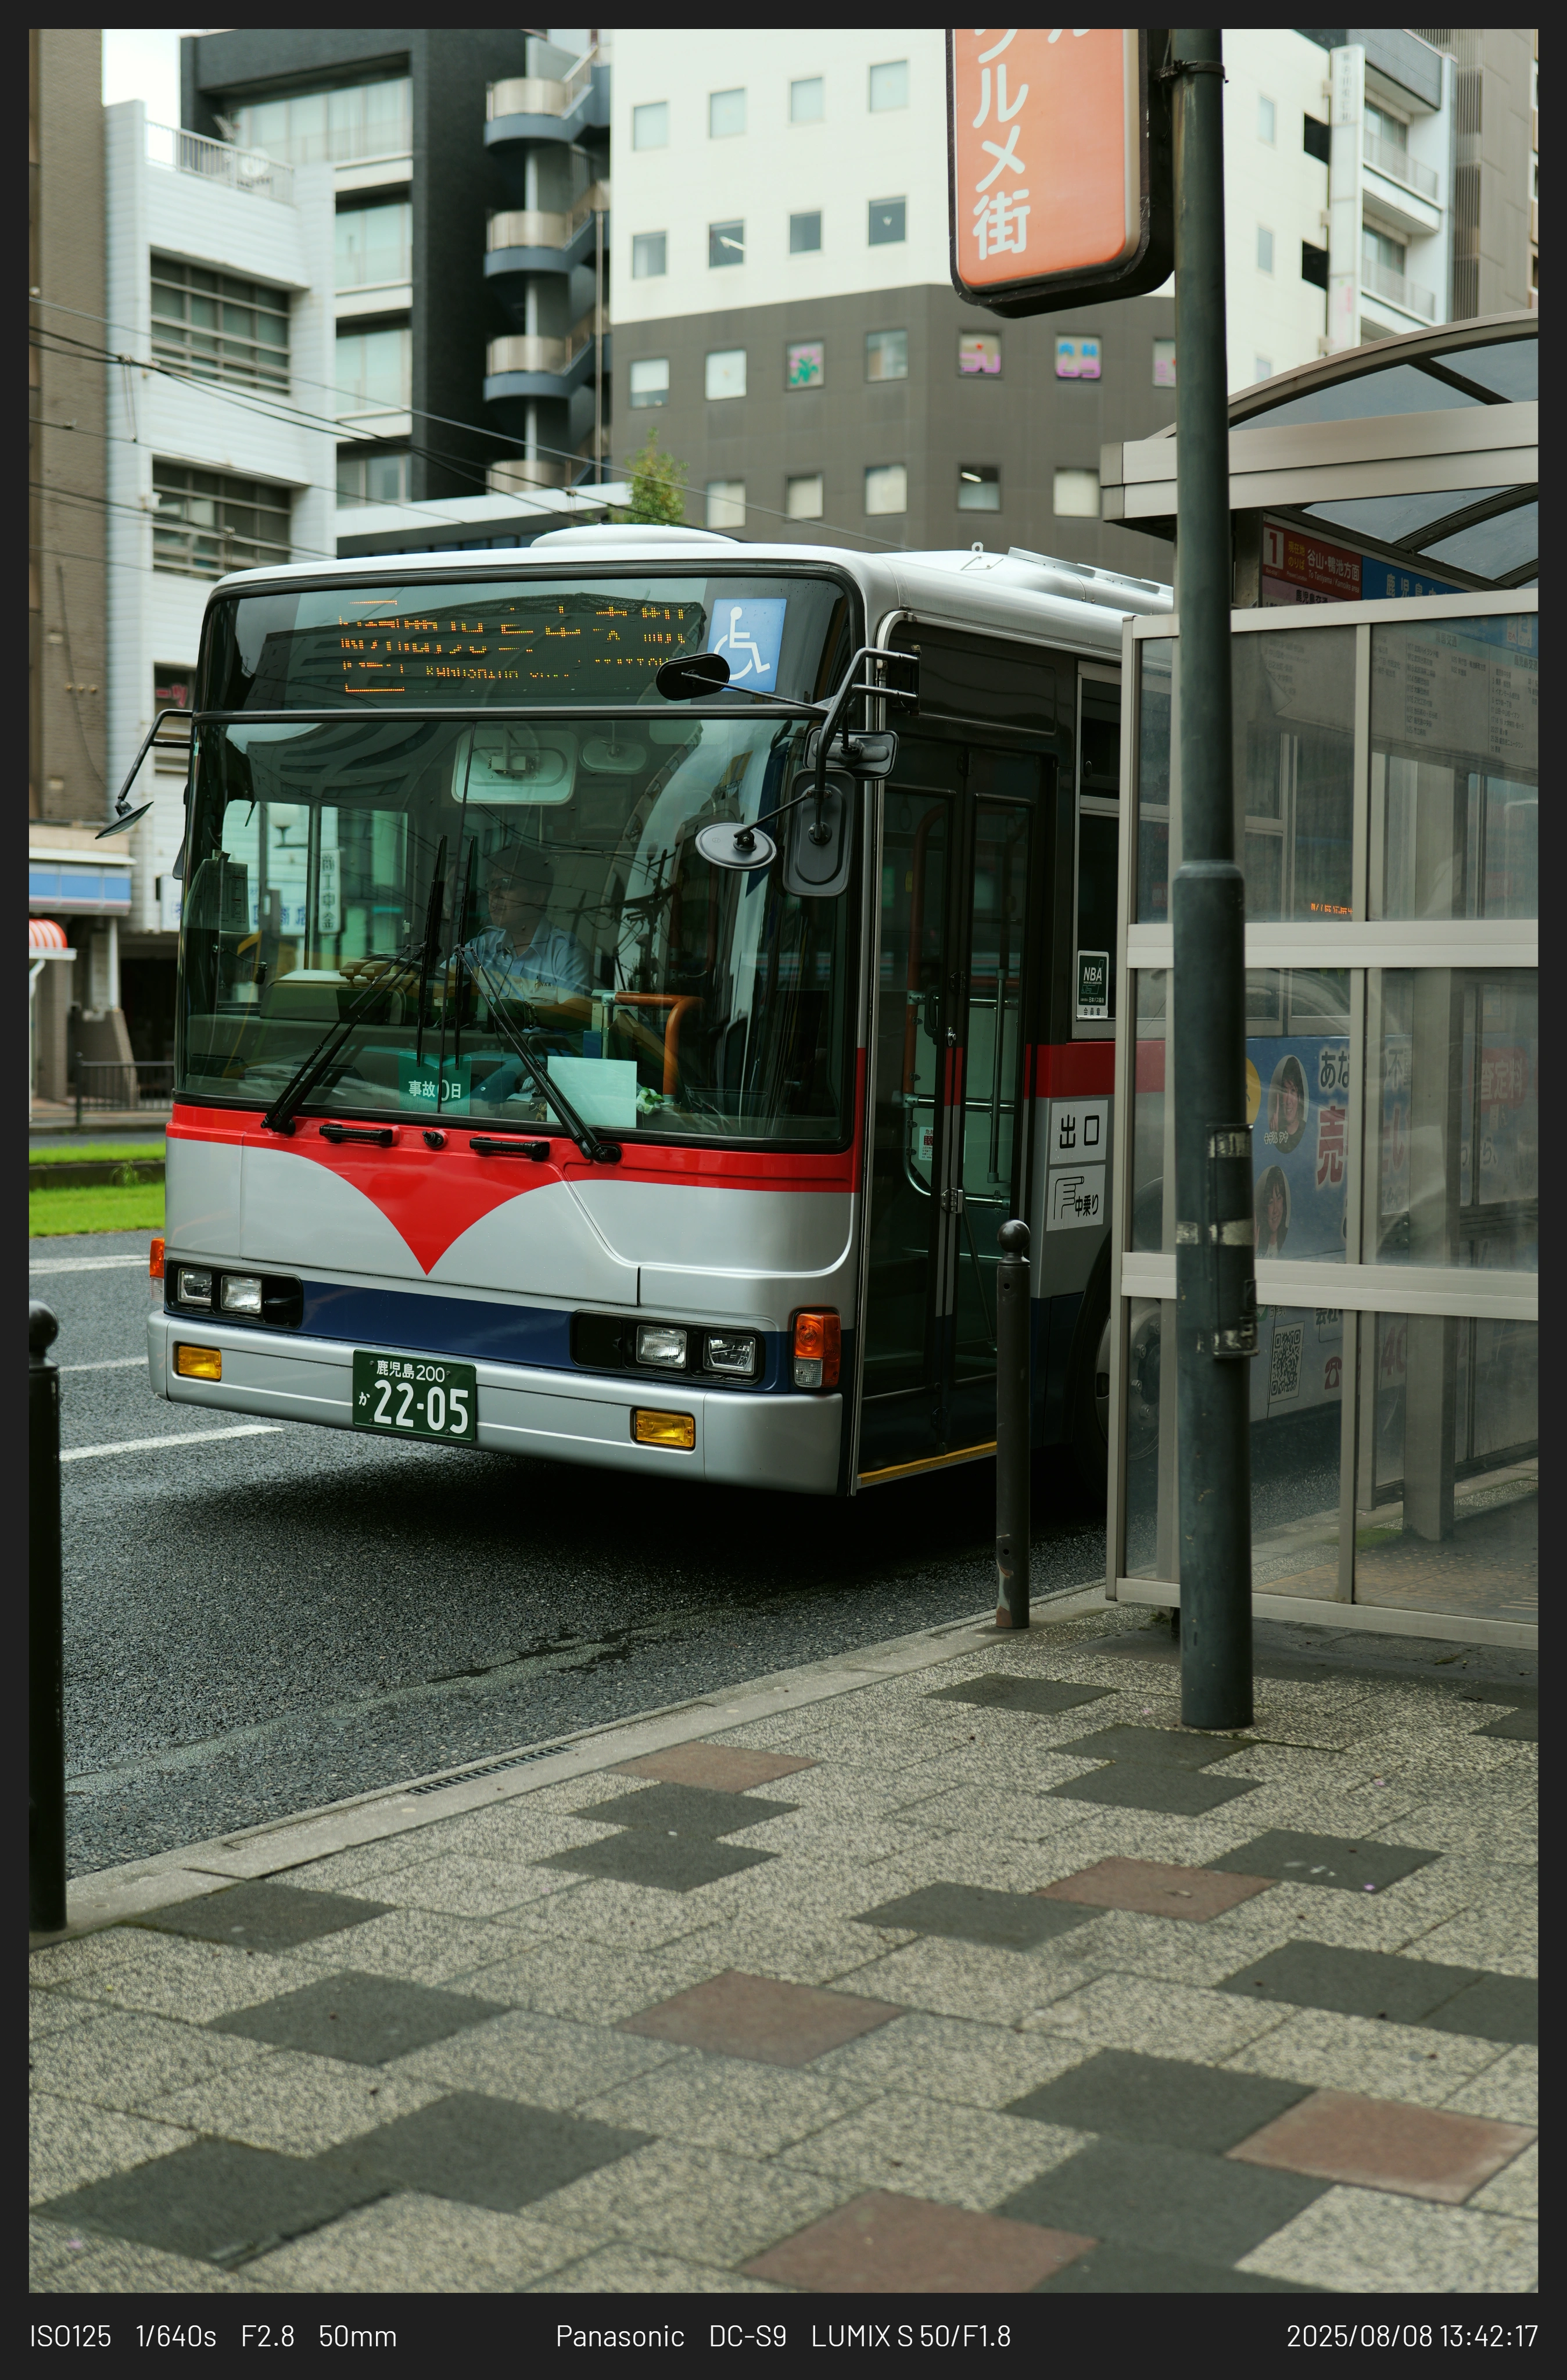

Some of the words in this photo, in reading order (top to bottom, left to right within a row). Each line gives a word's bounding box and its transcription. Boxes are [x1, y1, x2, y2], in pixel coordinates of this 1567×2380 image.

[1269, 531, 1278, 565] 1
[1288, 540, 1306, 556] 現在地
[1288, 555, 1306, 570] のりば
[1307, 549, 1360, 582] 谷山・鴨池方面
[1308, 569, 1314, 578] To
[1314, 572, 1332, 584] Taniyama
[1335, 578, 1351, 590] Kamoike
[1084, 966, 1102, 981] NBA
[1084, 1007, 1100, 1016] 会員章
[1059, 1114, 1100, 1149] 出口
[1075, 1193, 1099, 1218] 中乗り
[376, 1360, 445, 1383] 鹿児島200
[358, 1391, 370, 1406] か
[374, 1379, 468, 1434] 22-05
